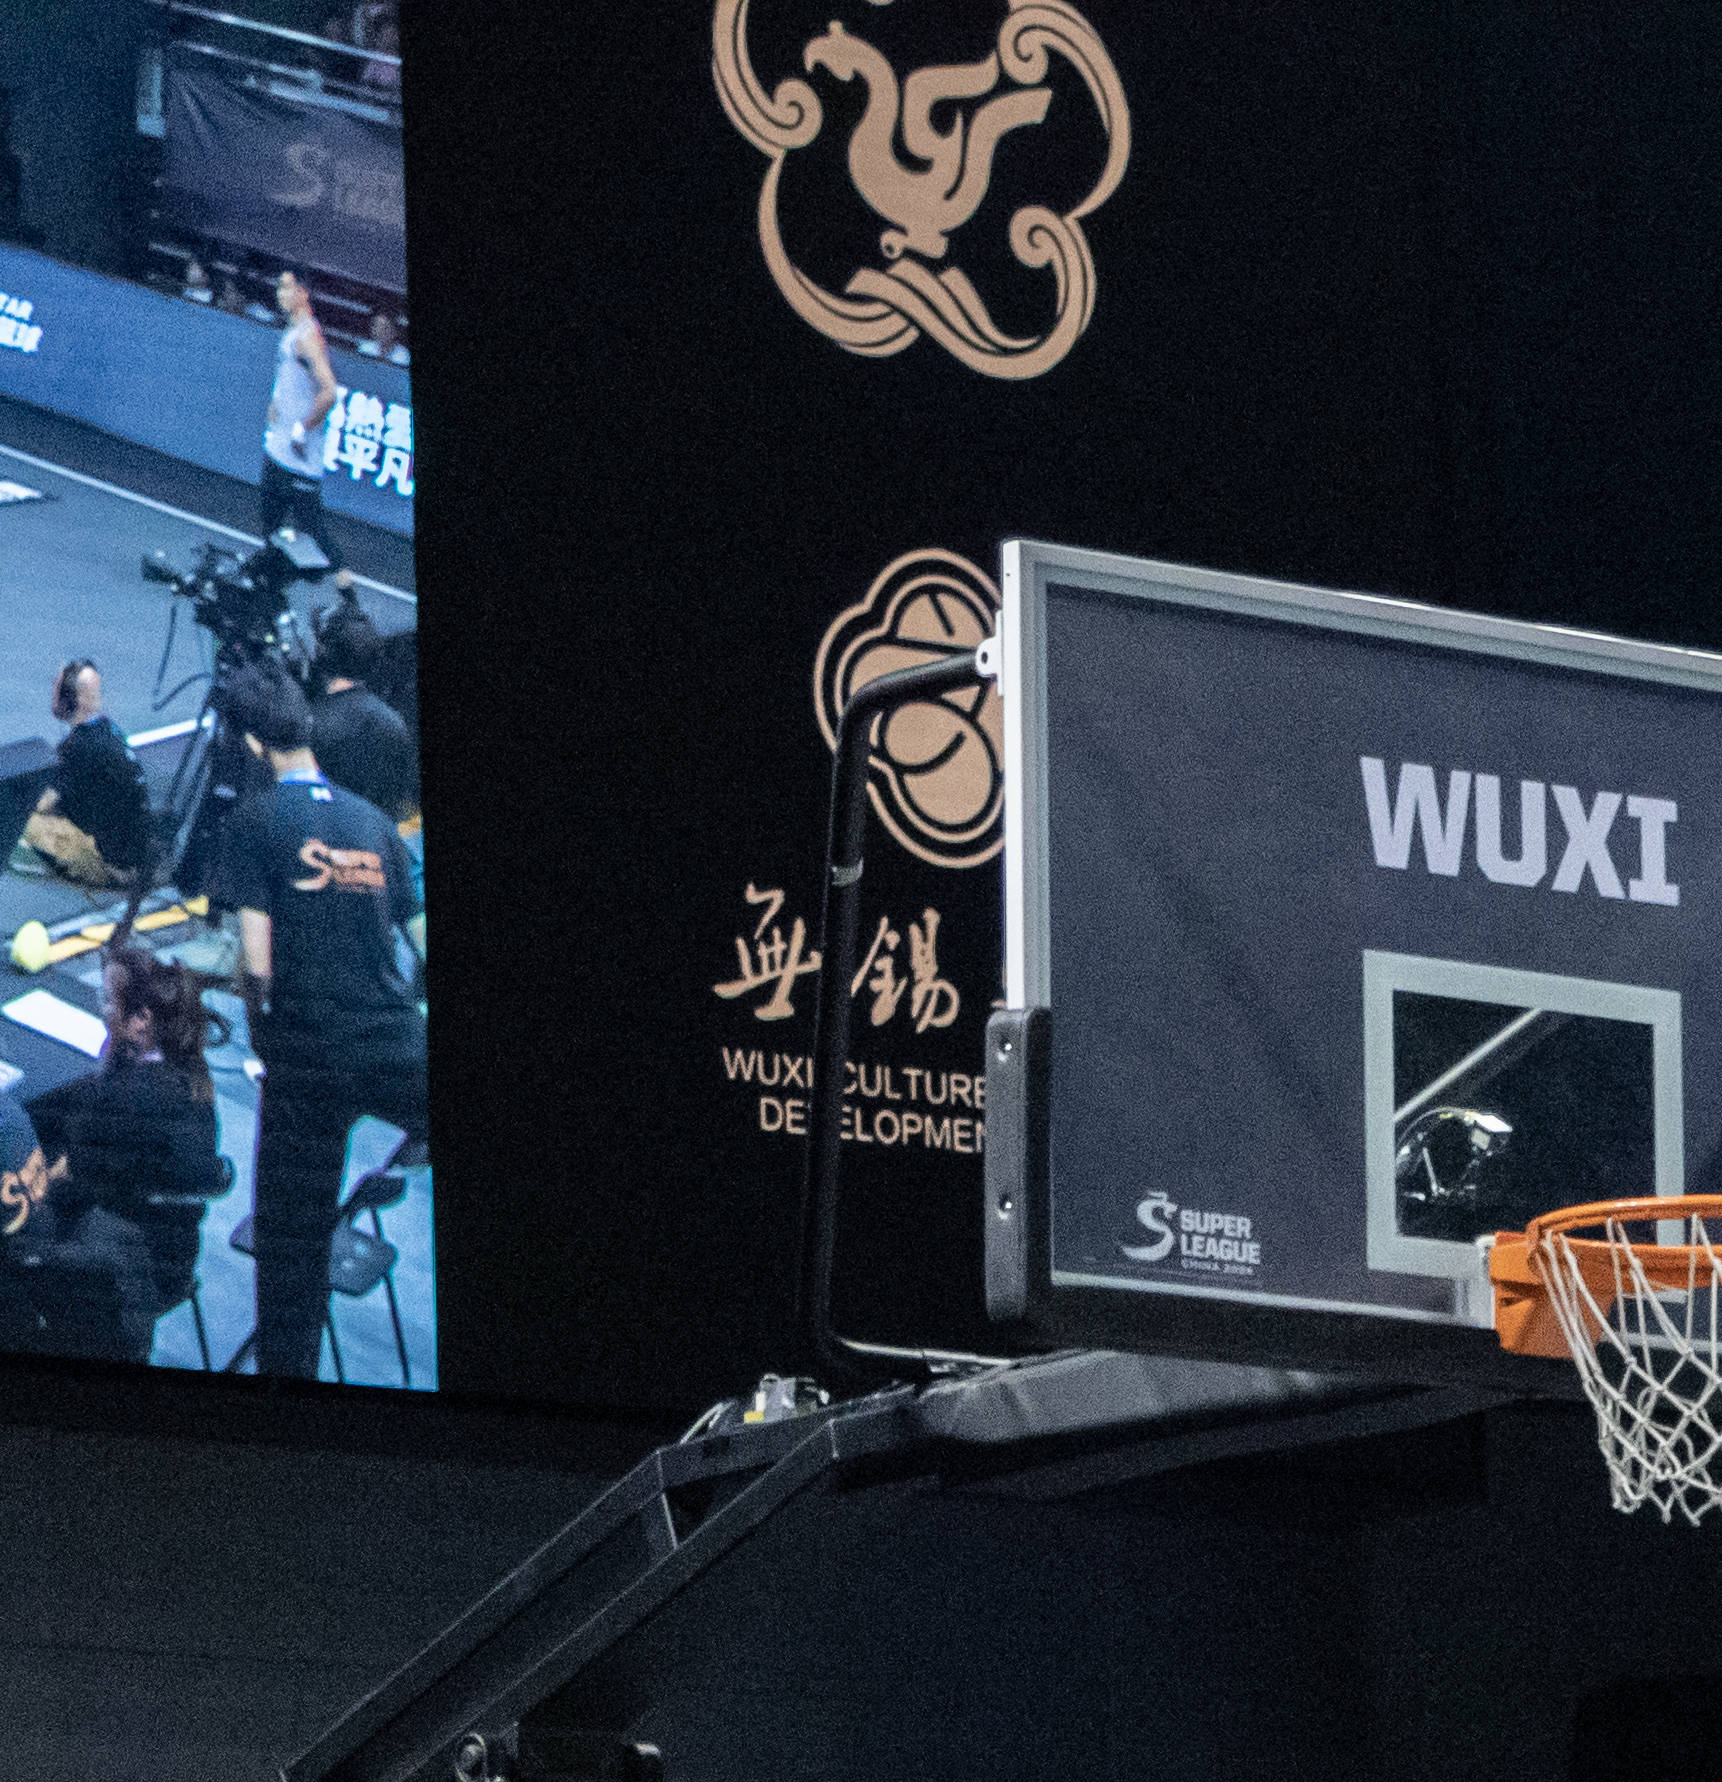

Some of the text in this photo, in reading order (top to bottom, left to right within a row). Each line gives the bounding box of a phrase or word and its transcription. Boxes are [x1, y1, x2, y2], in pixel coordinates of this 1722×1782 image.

[1359, 755, 1681, 907] WUXI
[722, 1046, 815, 1089] WUXI
[1179, 1208, 1252, 1239] SUPER
[1180, 1233, 1261, 1265] LEAGUE
